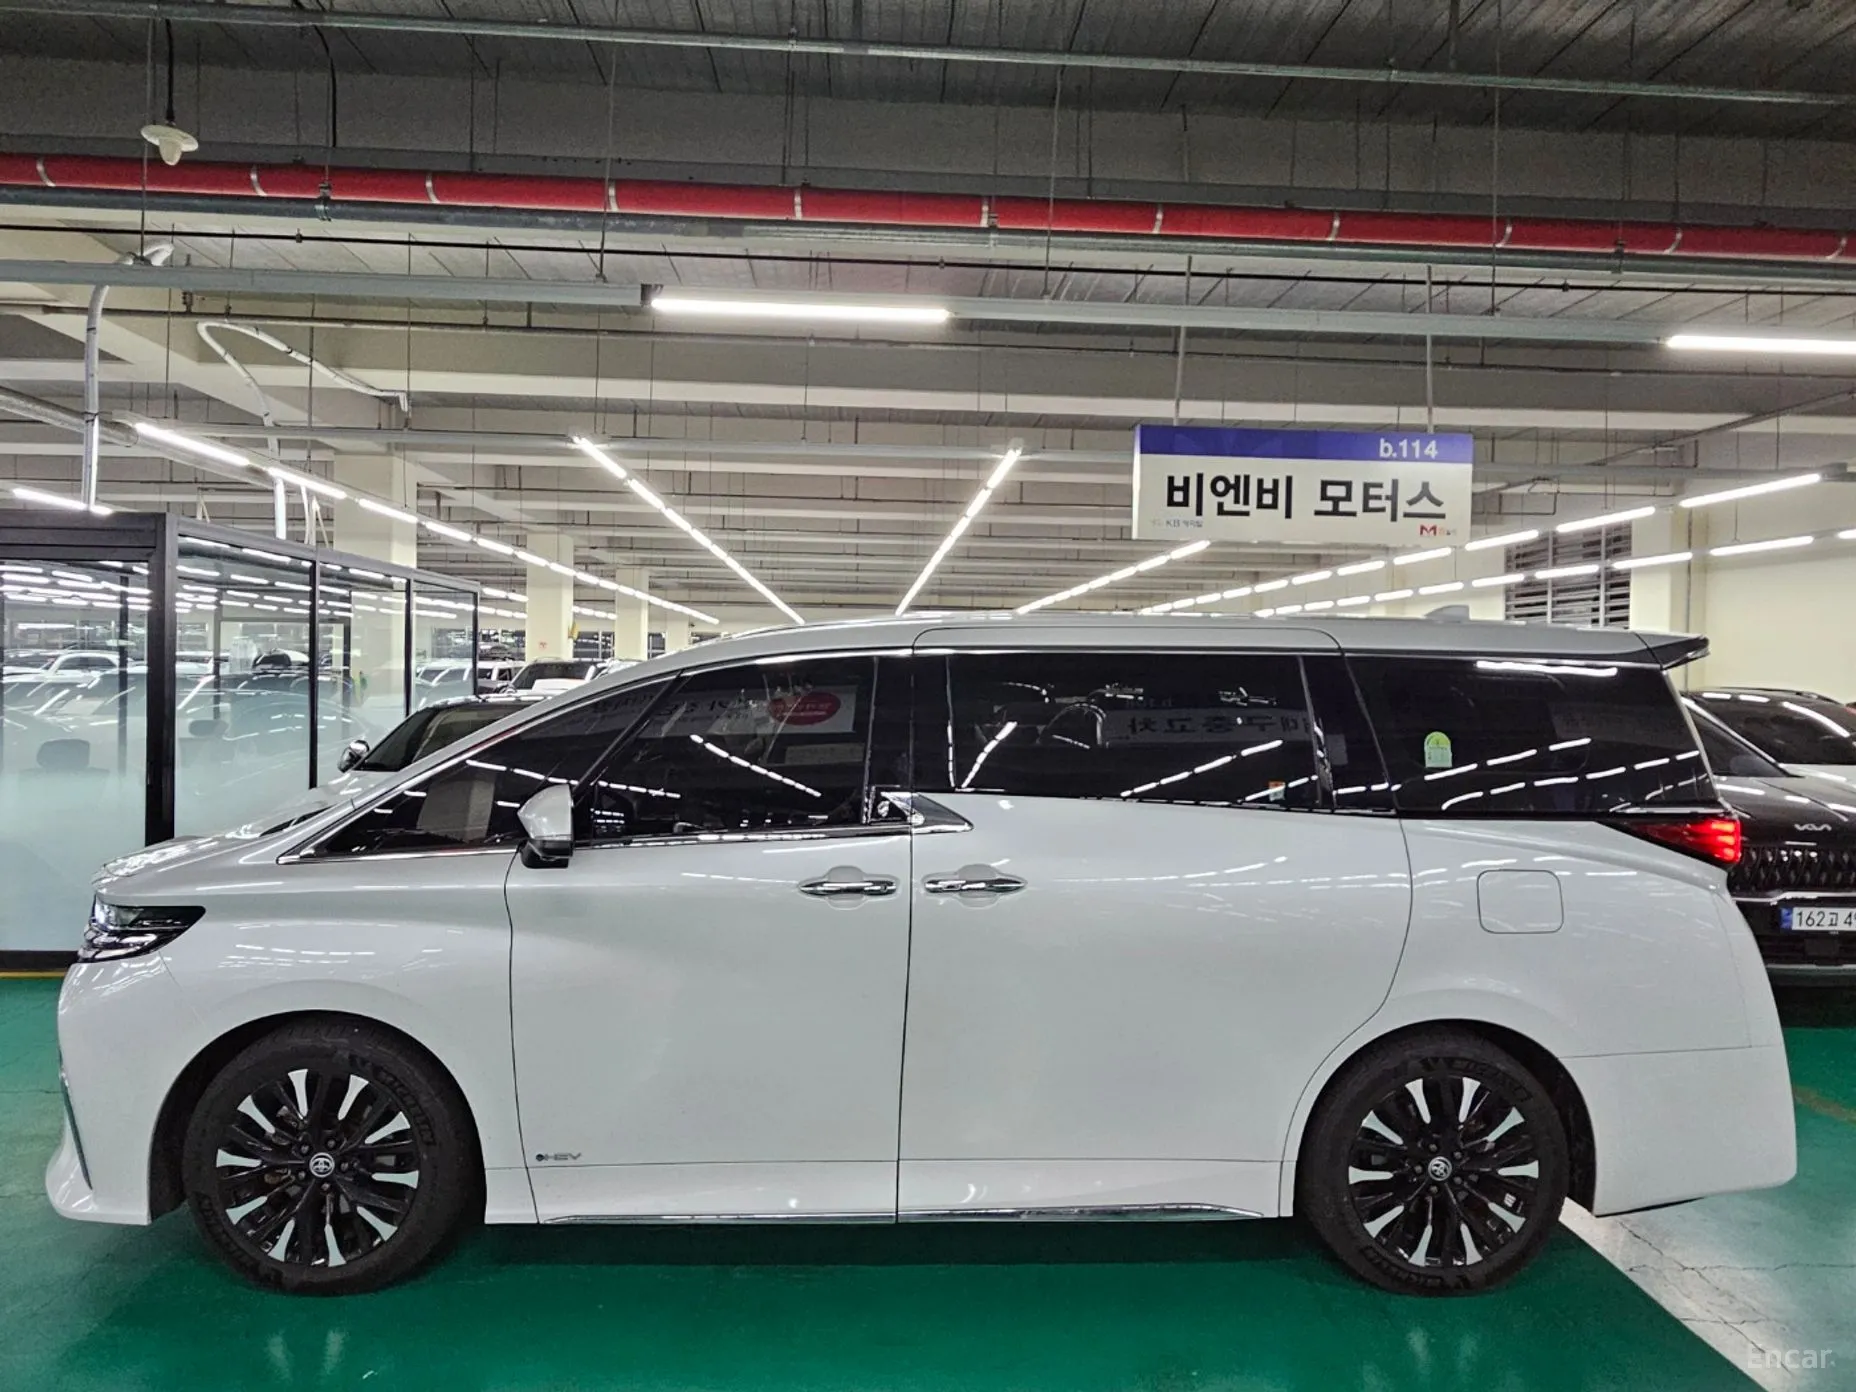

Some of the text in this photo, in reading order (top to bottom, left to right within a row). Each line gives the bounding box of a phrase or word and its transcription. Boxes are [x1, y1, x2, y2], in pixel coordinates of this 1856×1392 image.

[1380, 437, 1438, 460] b.114
[1167, 473, 1446, 522] 비엔비 모터스
[1843, 911, 1856, 927] 4
